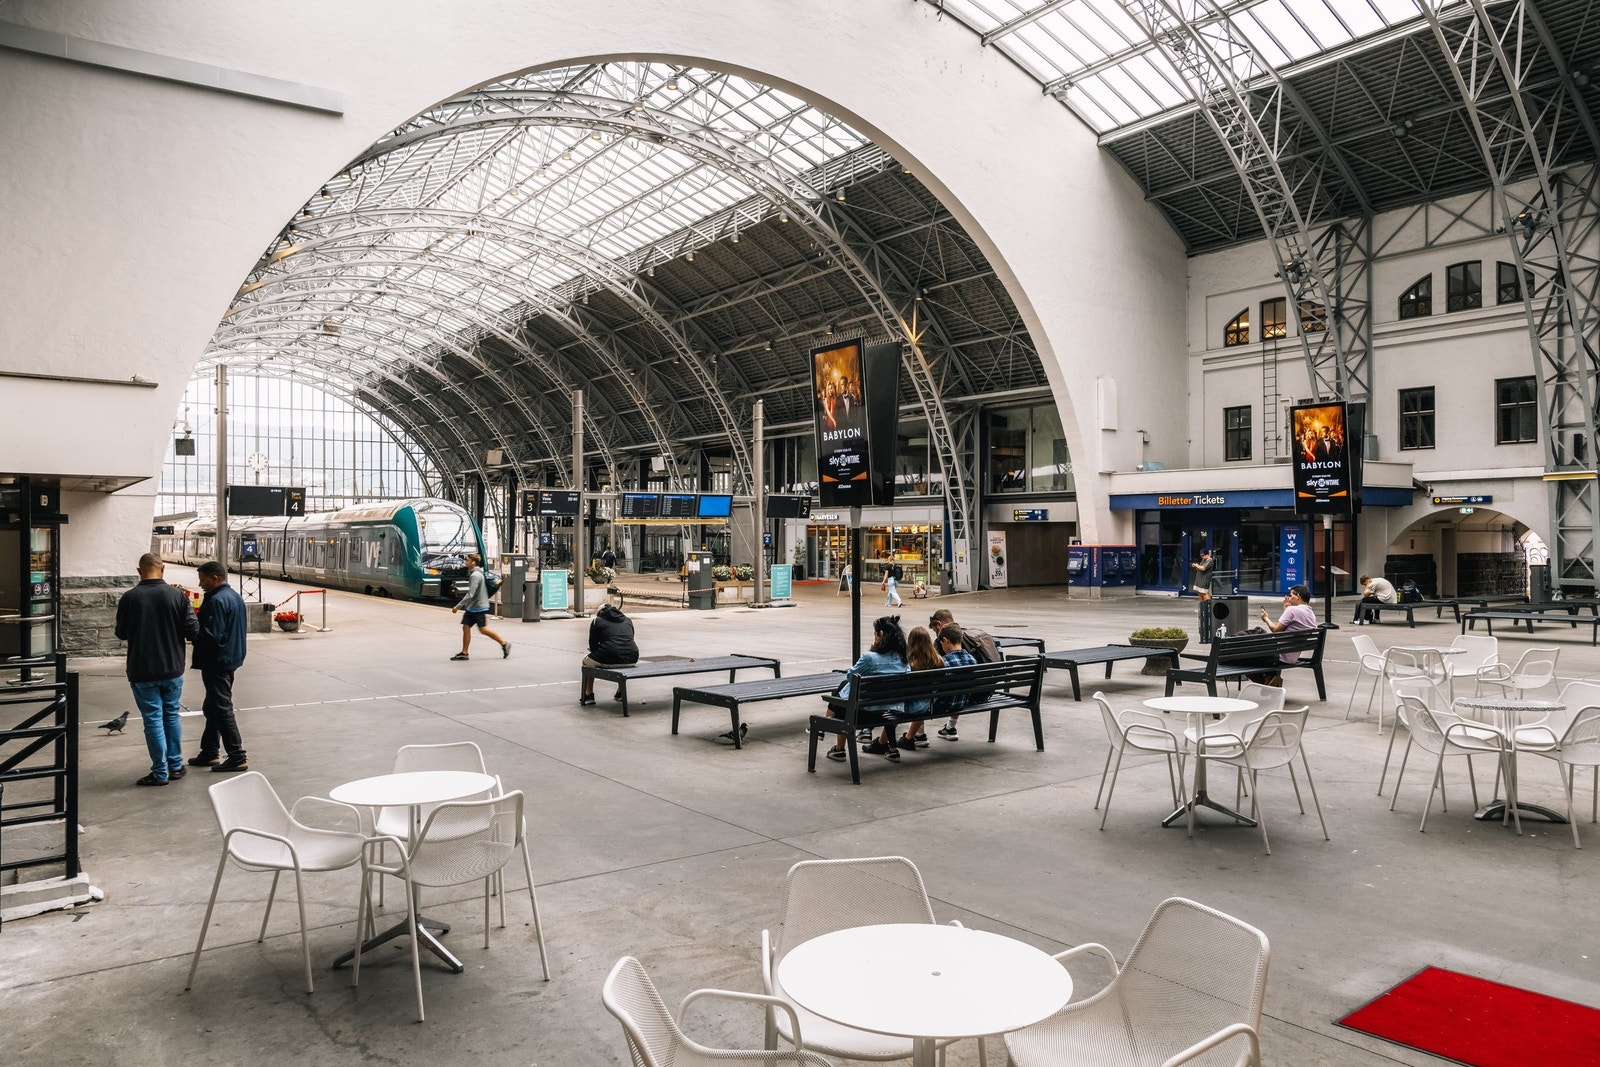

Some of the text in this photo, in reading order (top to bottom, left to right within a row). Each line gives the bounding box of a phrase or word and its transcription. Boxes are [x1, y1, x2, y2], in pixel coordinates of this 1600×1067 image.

[823, 428, 861, 441] BABYLON
[1301, 461, 1341, 470] BABYLON
[1158, 495, 1225, 506] Billetter Tickets
[291, 502, 299, 512] 4
[527, 502, 533, 512] 3
